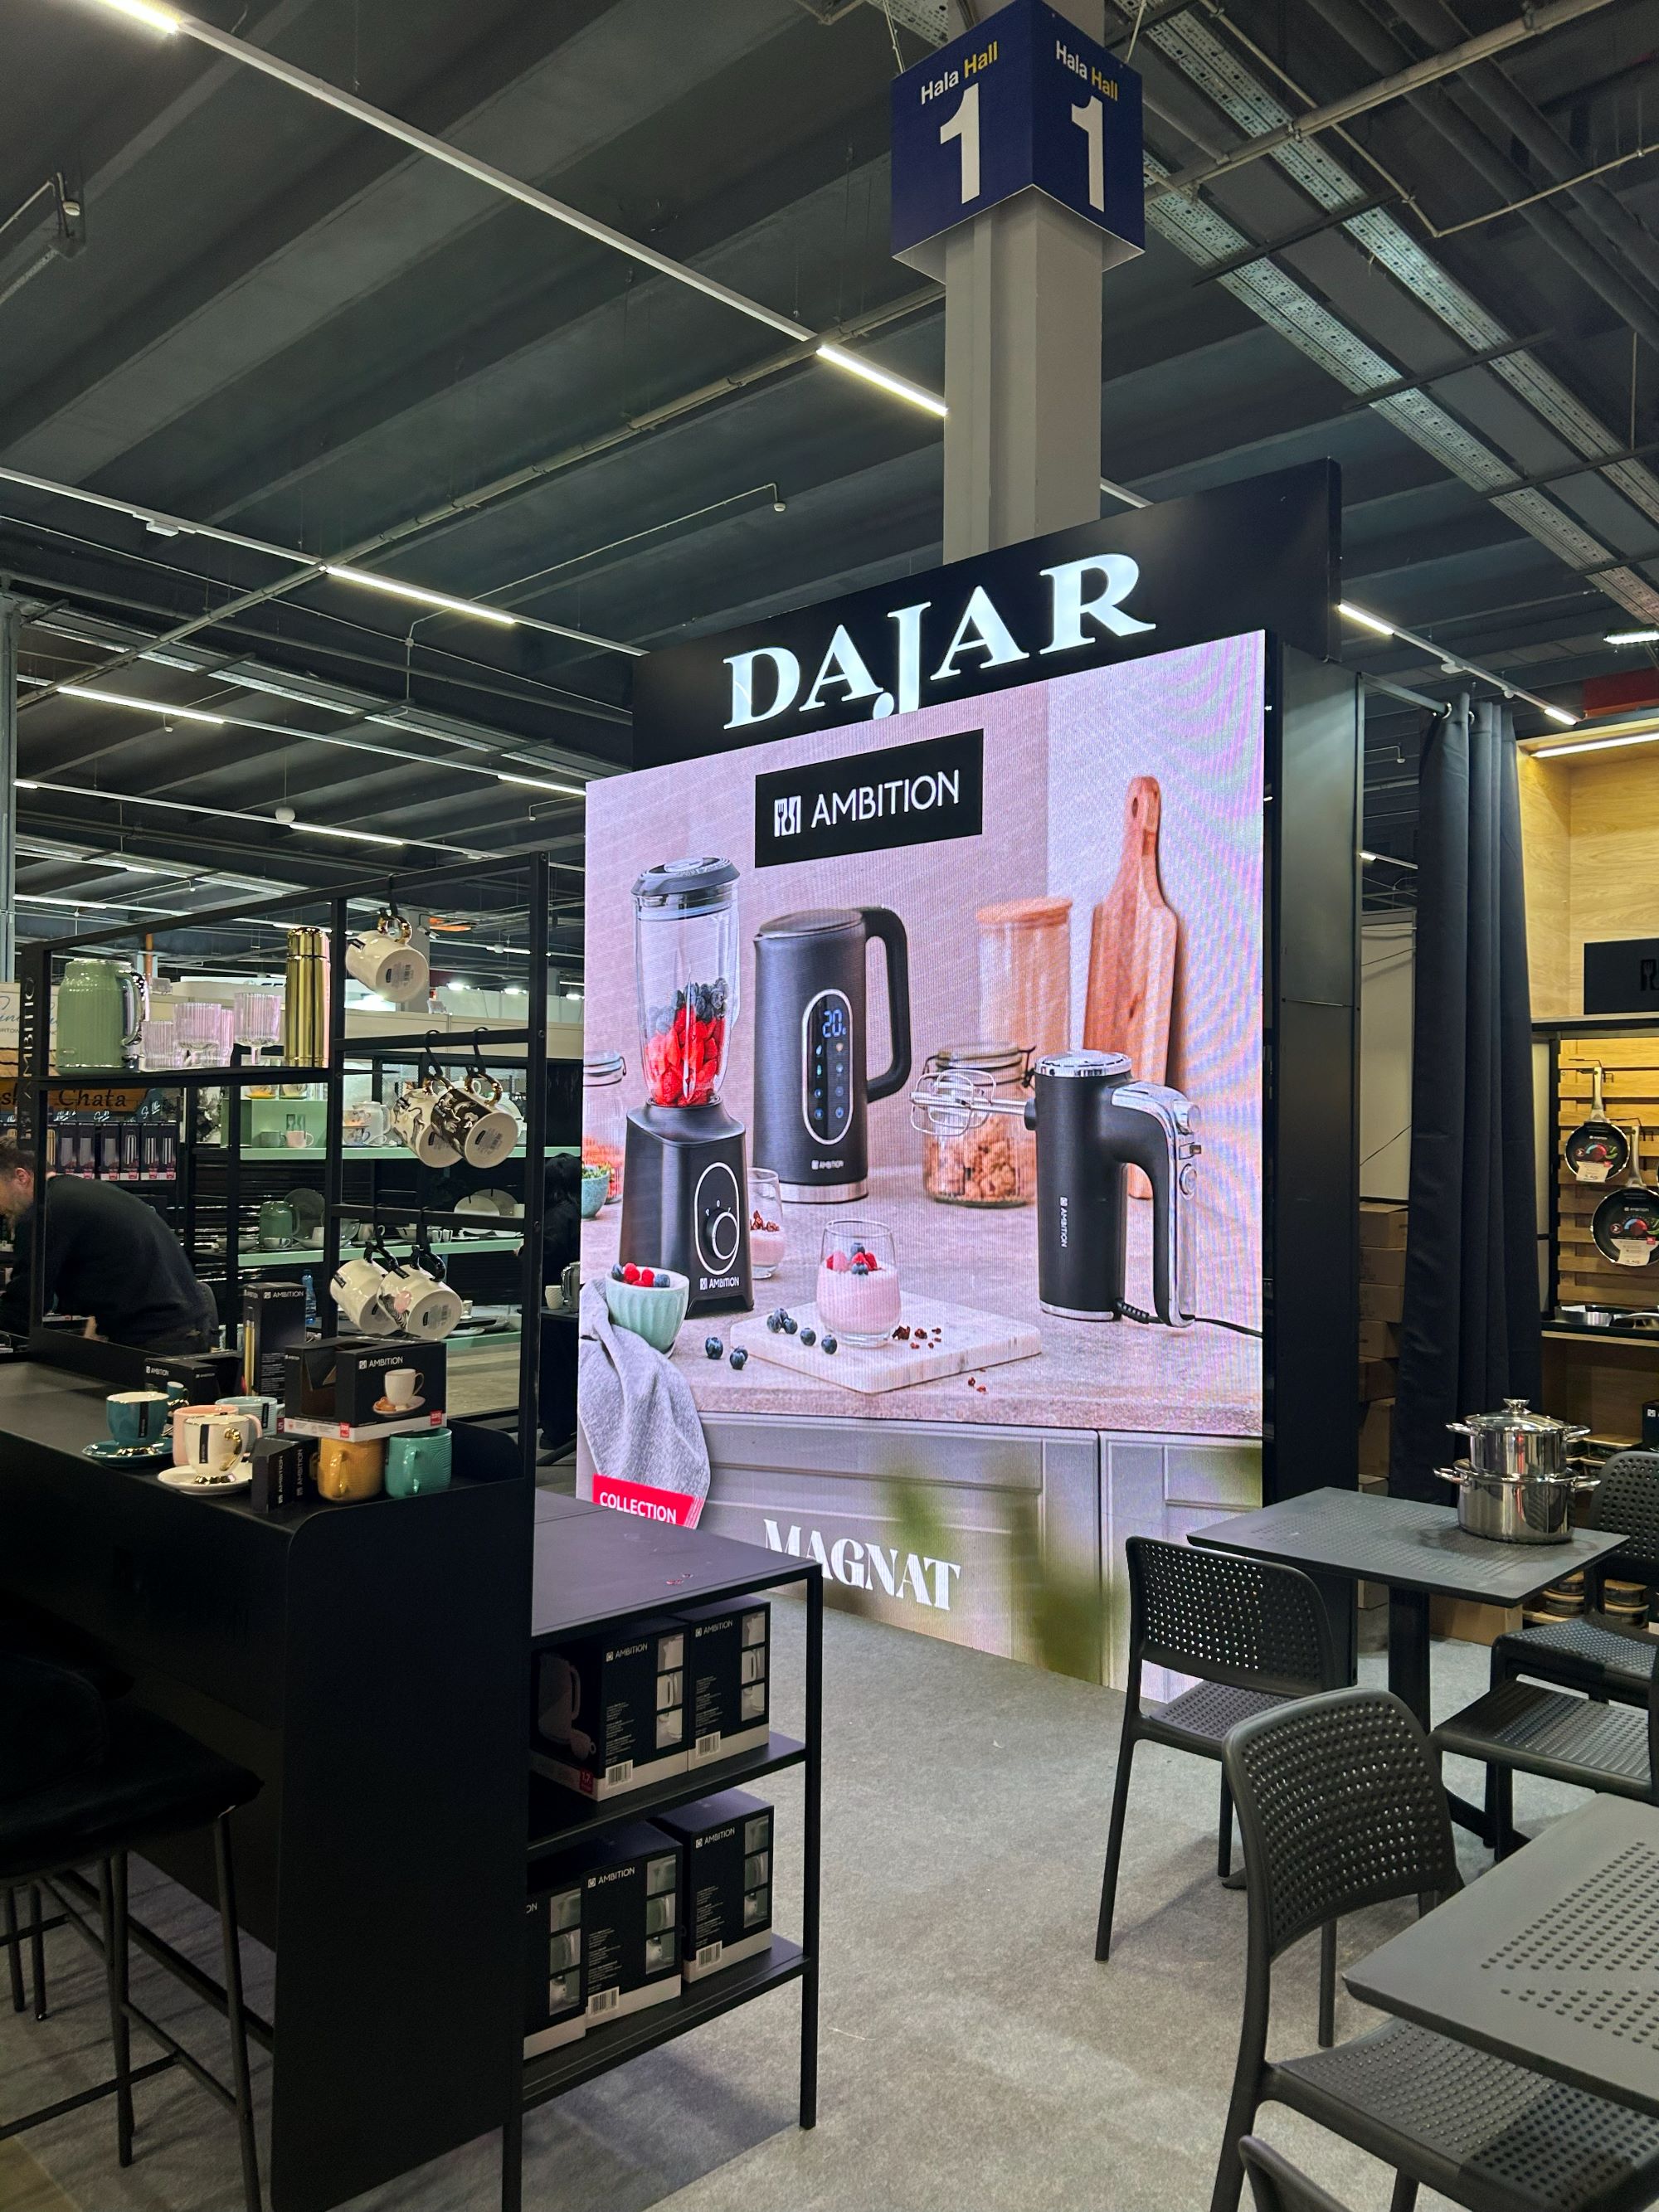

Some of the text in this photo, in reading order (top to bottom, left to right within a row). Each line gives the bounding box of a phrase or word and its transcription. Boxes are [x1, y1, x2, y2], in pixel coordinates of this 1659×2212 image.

[921, 40, 998, 105] Hala Hall
[1055, 40, 1118, 101] Hala Hall
[940, 82, 980, 205] 1
[1071, 95, 1105, 213] 1
[722, 552, 1156, 729] DAJAR
[810, 769, 960, 829] AMBITION
[58, 1087, 127, 1107] Chata
[1059, 1208, 1068, 1248] AMBITION
[273, 1291, 304, 1299] AMBITION
[708, 1276, 740, 1287] AMBITION
[368, 1356, 403, 1368] AMBITION
[599, 1491, 677, 1525] COLLECTION
[763, 1519, 961, 1611] MAGNAT
[703, 1619, 733, 1635] AMBITION
[615, 1642, 648, 1659] AMBITION
[704, 1826, 735, 1845] AMBITION
[598, 1866, 635, 1885] AMBITION
